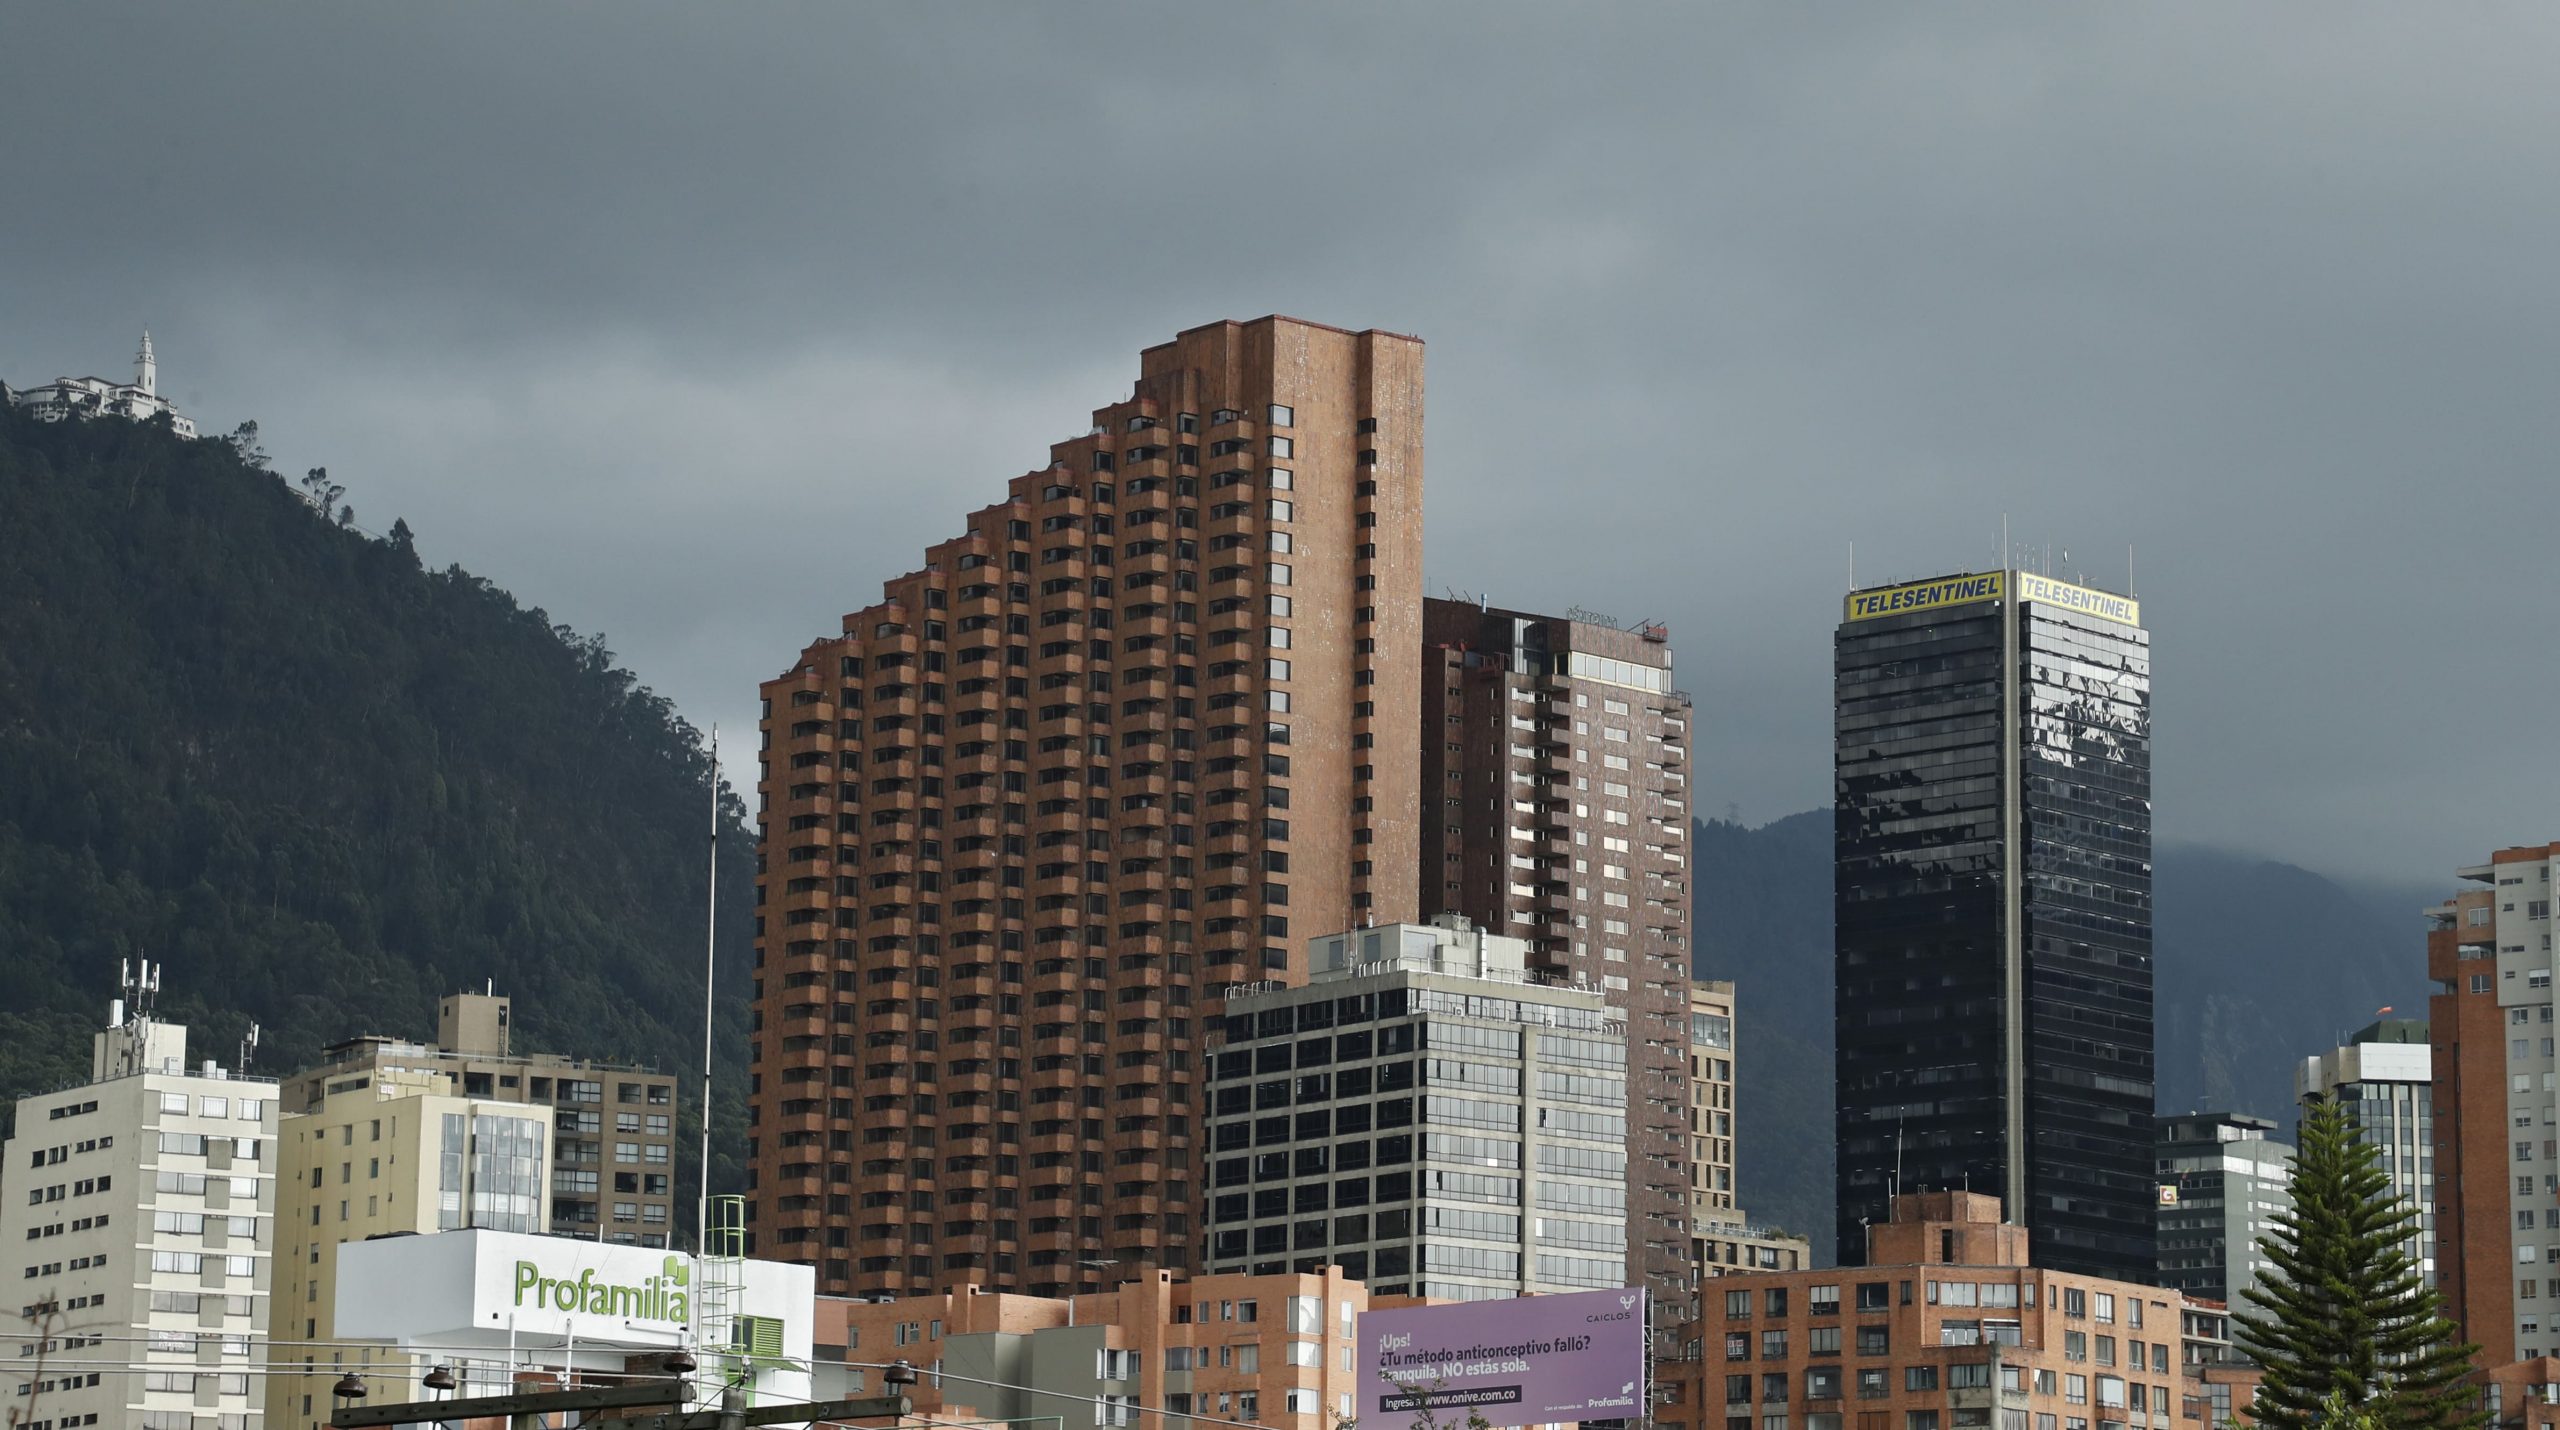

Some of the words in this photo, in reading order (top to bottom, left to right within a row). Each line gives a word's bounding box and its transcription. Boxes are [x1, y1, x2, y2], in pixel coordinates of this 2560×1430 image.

[1855, 576, 1999, 616] TELESENTINEL
[2025, 577, 2132, 621] TELESENTINEL
[515, 1260, 688, 1322] Profamilia
[1586, 1312, 1631, 1323] CAICLOS
[1380, 1332, 1411, 1353] ¡Ups!
[1380, 1352, 1401, 1366] ¿Tu
[1404, 1347, 1453, 1365] método
[1456, 1339, 1551, 1360] anticonceptivo
[1554, 1335, 1591, 1352] falló?
[1442, 1361, 1464, 1377] NO
[1466, 1358, 1499, 1376] estás
[1501, 1357, 1530, 1373] sola.
[1588, 1396, 1634, 1408] Profamilia
